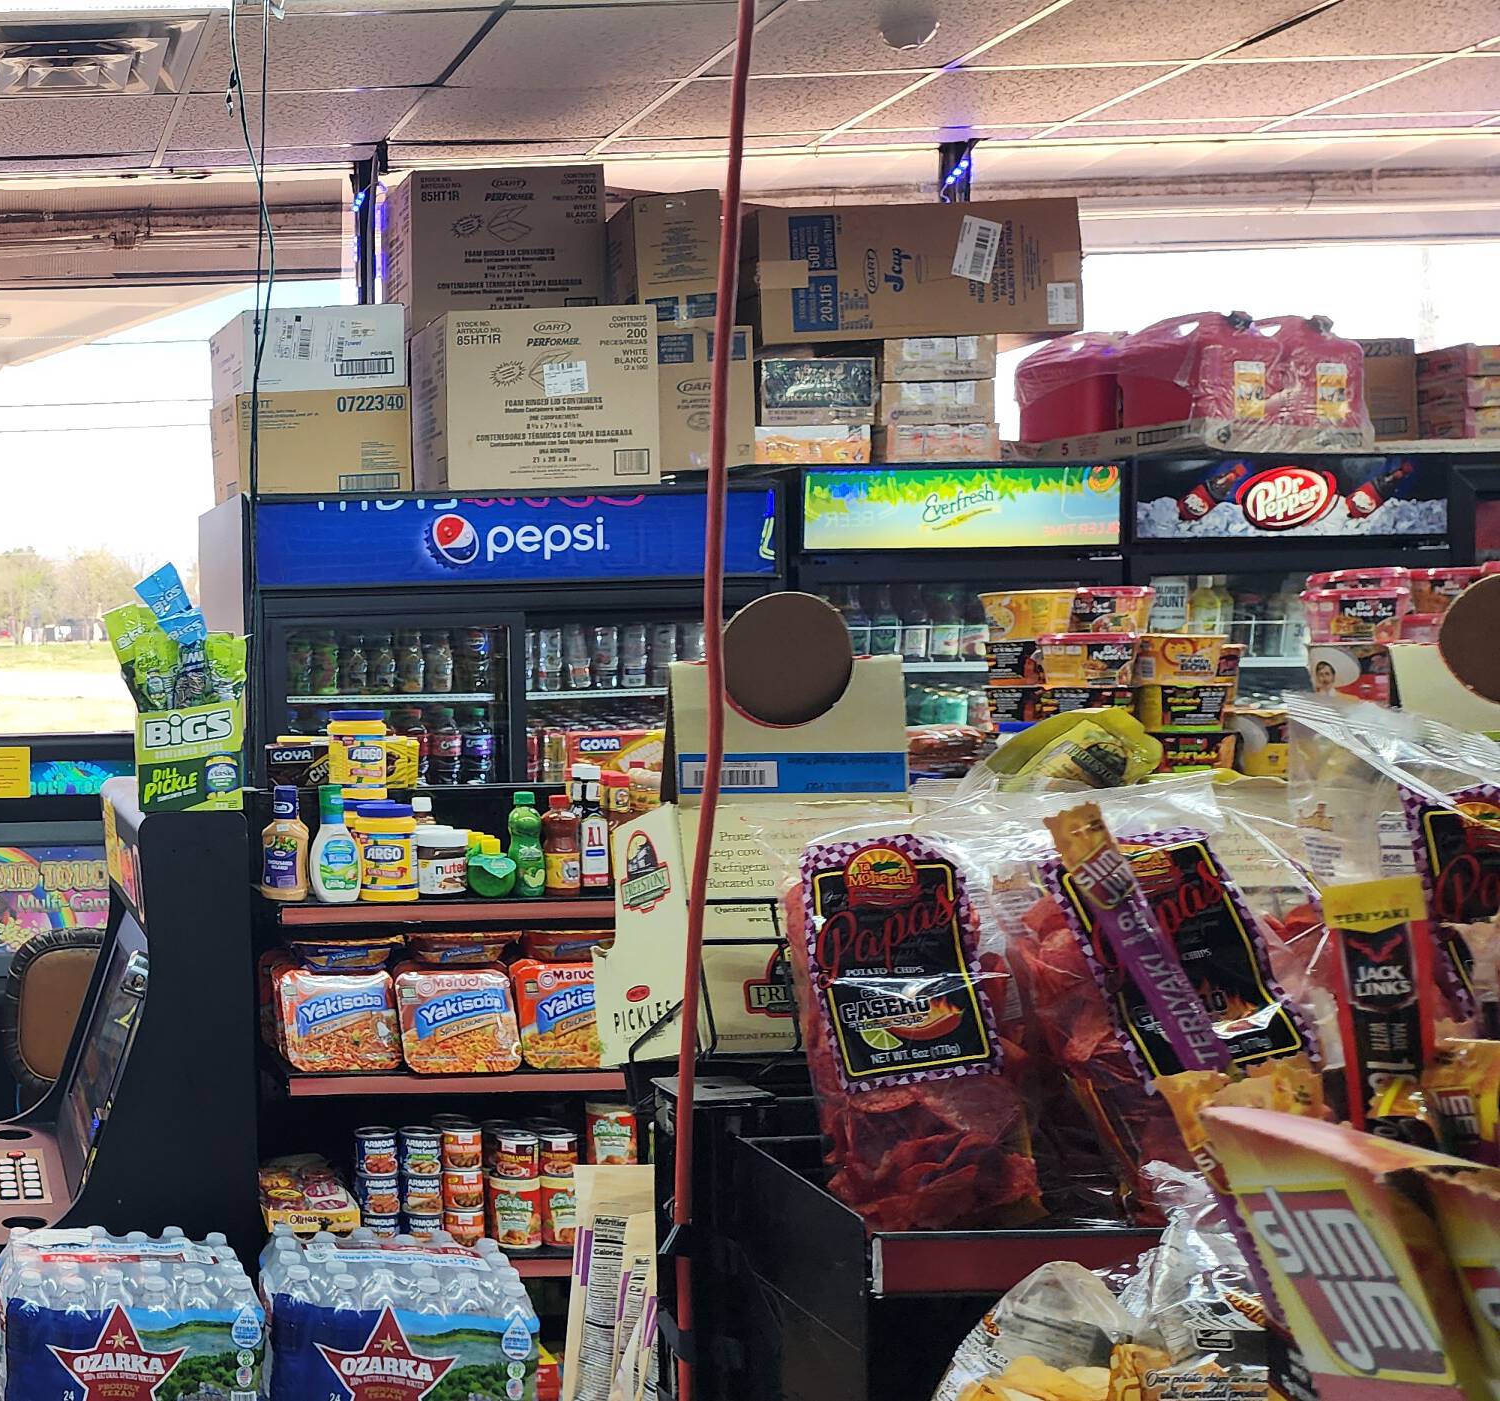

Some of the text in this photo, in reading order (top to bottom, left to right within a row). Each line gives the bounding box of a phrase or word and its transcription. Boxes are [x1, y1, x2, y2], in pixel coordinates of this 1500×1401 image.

[421, 190, 460, 202] 85HT1R
[484, 192, 534, 201] PERFORMER
[577, 185, 597, 195] 200
[808, 246, 820, 268] 500
[868, 249, 876, 293] DART
[820, 284, 833, 322] 20J16
[538, 323, 566, 331] DART
[626, 328, 648, 338] 200
[457, 334, 501, 345] 85HT1R
[683, 382, 711, 392] DAR
[241, 400, 273, 409] SCTT
[1061, 443, 1069, 456] 5
[1273, 476, 1303, 498] Dr
[922, 484, 995, 523] Everfresh
[1252, 480, 1322, 522] Pepper
[486, 516, 607, 561] pepsi
[145, 710, 234, 749] BiGS
[580, 738, 620, 752] GOYA
[272, 747, 314, 764] GOYA
[350, 746, 384, 762] ARGO
[153, 769, 178, 784] DILL
[144, 771, 199, 805] PICKLE
[365, 845, 402, 861] ARGO
[709, 848, 734, 859] eep
[1334, 907, 1411, 925] TERIYAKI
[816, 884, 959, 987] Papas
[845, 965, 925, 976] POTATO CHIPS
[1356, 964, 1405, 982] JACK
[301, 993, 382, 1026] Yakisoba
[421, 995, 502, 1027] Yakisoba
[1138, 952, 1219, 1064] TERIYAKI
[871, 1051, 892, 1064] NET
[911, 1048, 930, 1060] 6oz
[364, 1139, 394, 1148] ARMOUR
[406, 1139, 437, 1148] ARMOUR
[366, 1179, 396, 1188] ARMOUR
[408, 1179, 440, 1188] ARMOUR
[364, 1218, 396, 1227] ARMOUR
[409, 1218, 440, 1227] ARMOUR
[73, 1353, 166, 1374] OZARKA
[340, 1357, 434, 1381] OZARKA
[1146, 1370, 1170, 1388] Our
[1171, 1371, 1203, 1385] potato
[1204, 1371, 1230, 1387] chips
[98, 1383, 141, 1392] PROUDLY
[102, 1390, 137, 1398] TEXAN
[63, 1390, 75, 1401] 24
